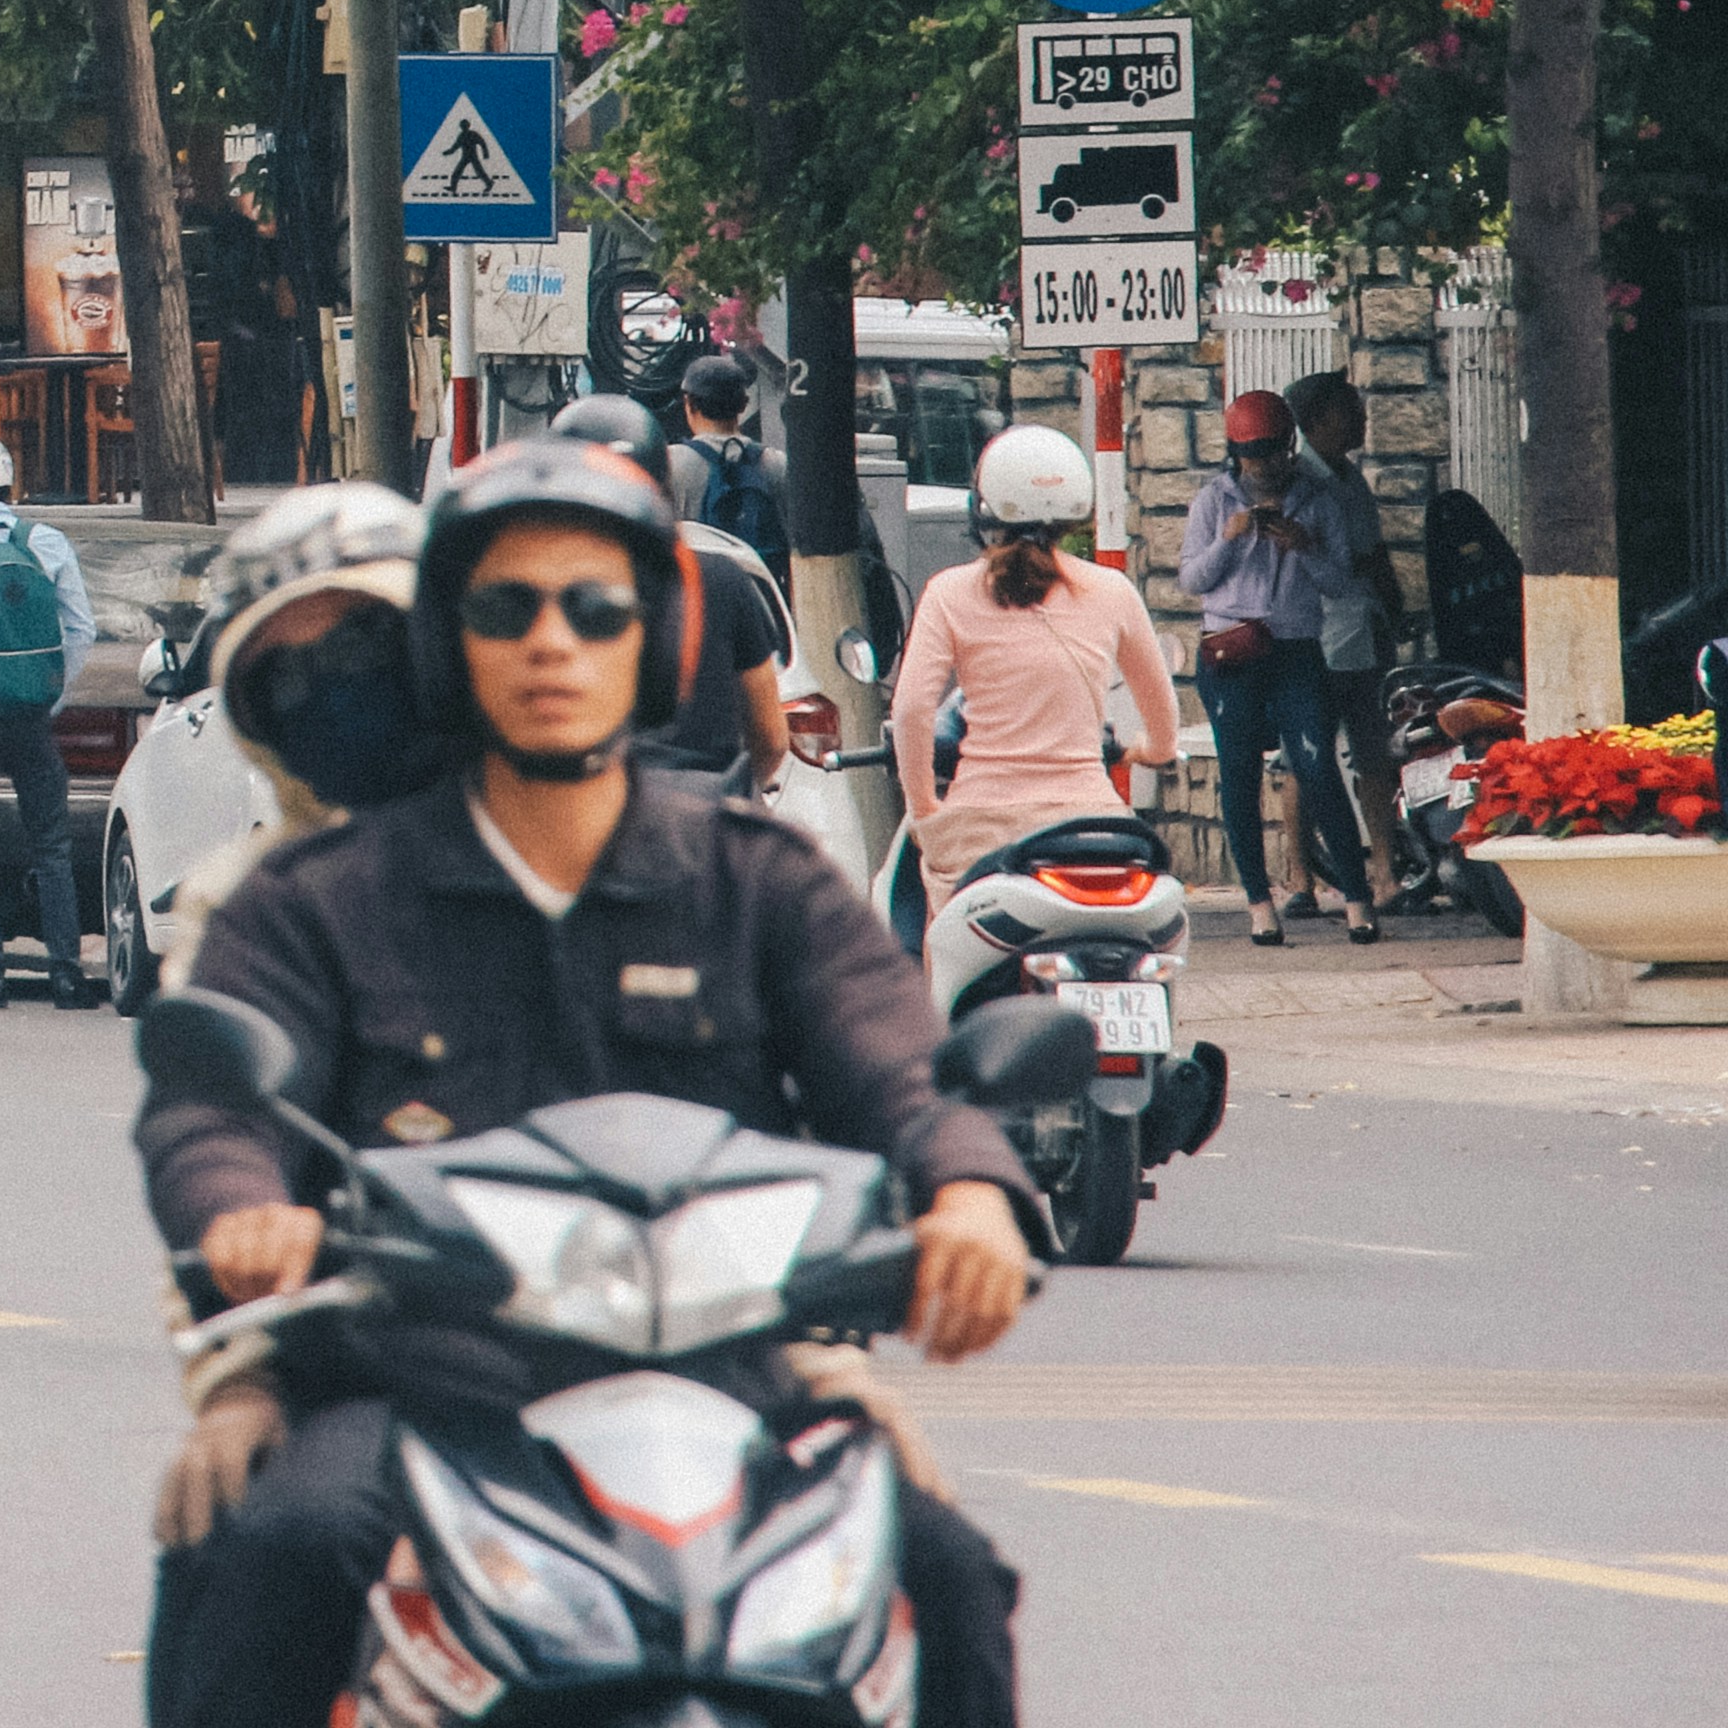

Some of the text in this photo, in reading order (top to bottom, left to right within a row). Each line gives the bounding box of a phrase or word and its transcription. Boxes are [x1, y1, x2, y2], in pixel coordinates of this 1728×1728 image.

[1123, 54, 1177, 91] CHỖ
[1033, 270, 1098, 323] 15:00
[1122, 267, 1185, 321] 23:00
